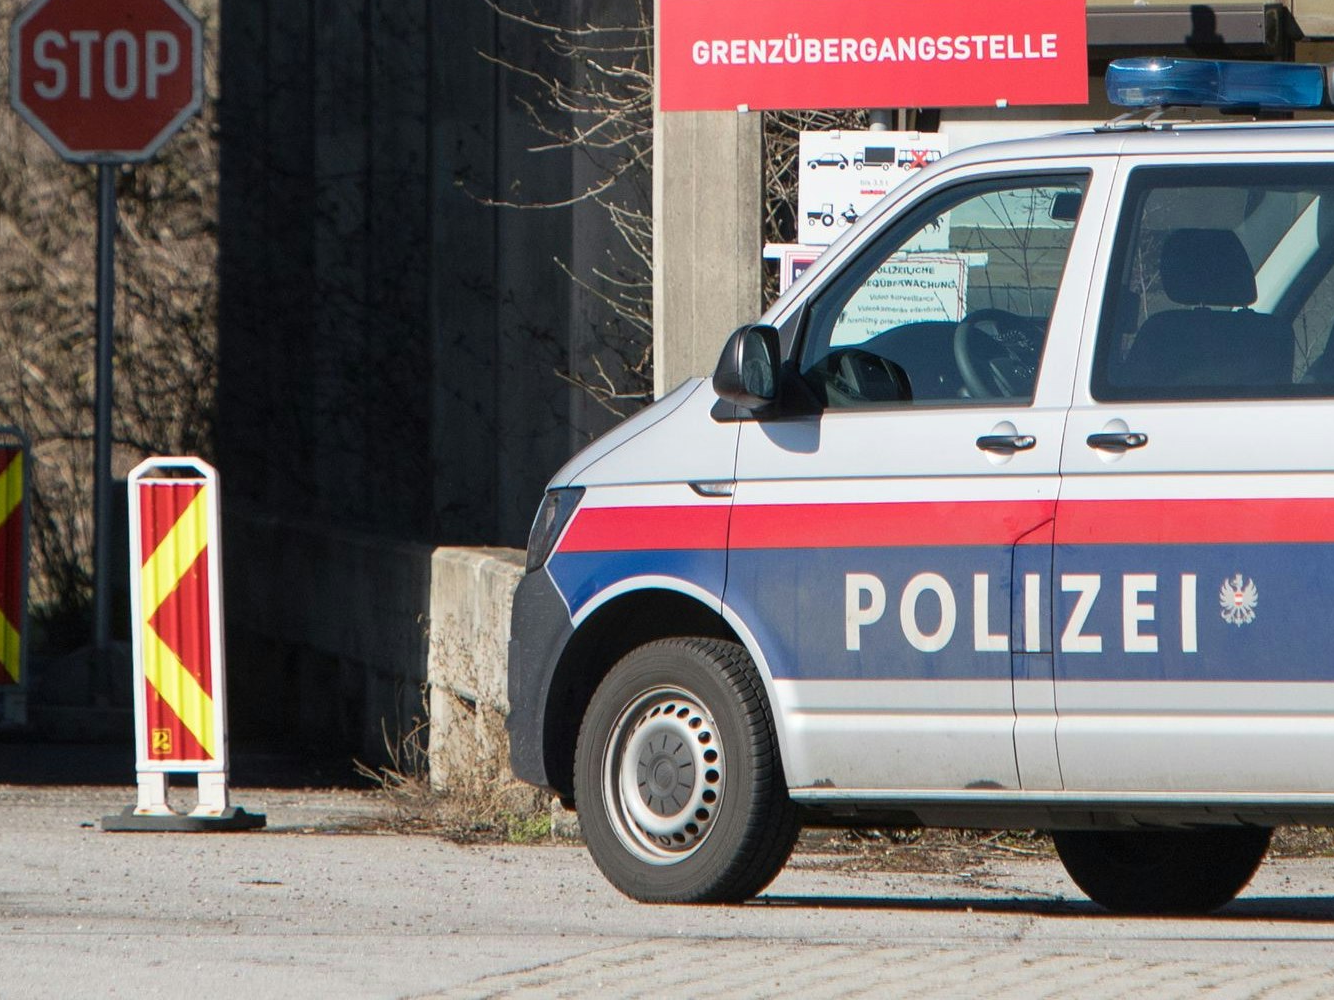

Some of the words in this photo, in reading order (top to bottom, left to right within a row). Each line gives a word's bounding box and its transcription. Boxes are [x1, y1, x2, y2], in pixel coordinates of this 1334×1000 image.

[33, 29, 179, 100] STOP
[692, 32, 1058, 65] GRENZÜBERGANGSSTELLE
[845, 572, 1198, 653] POLIZEI
